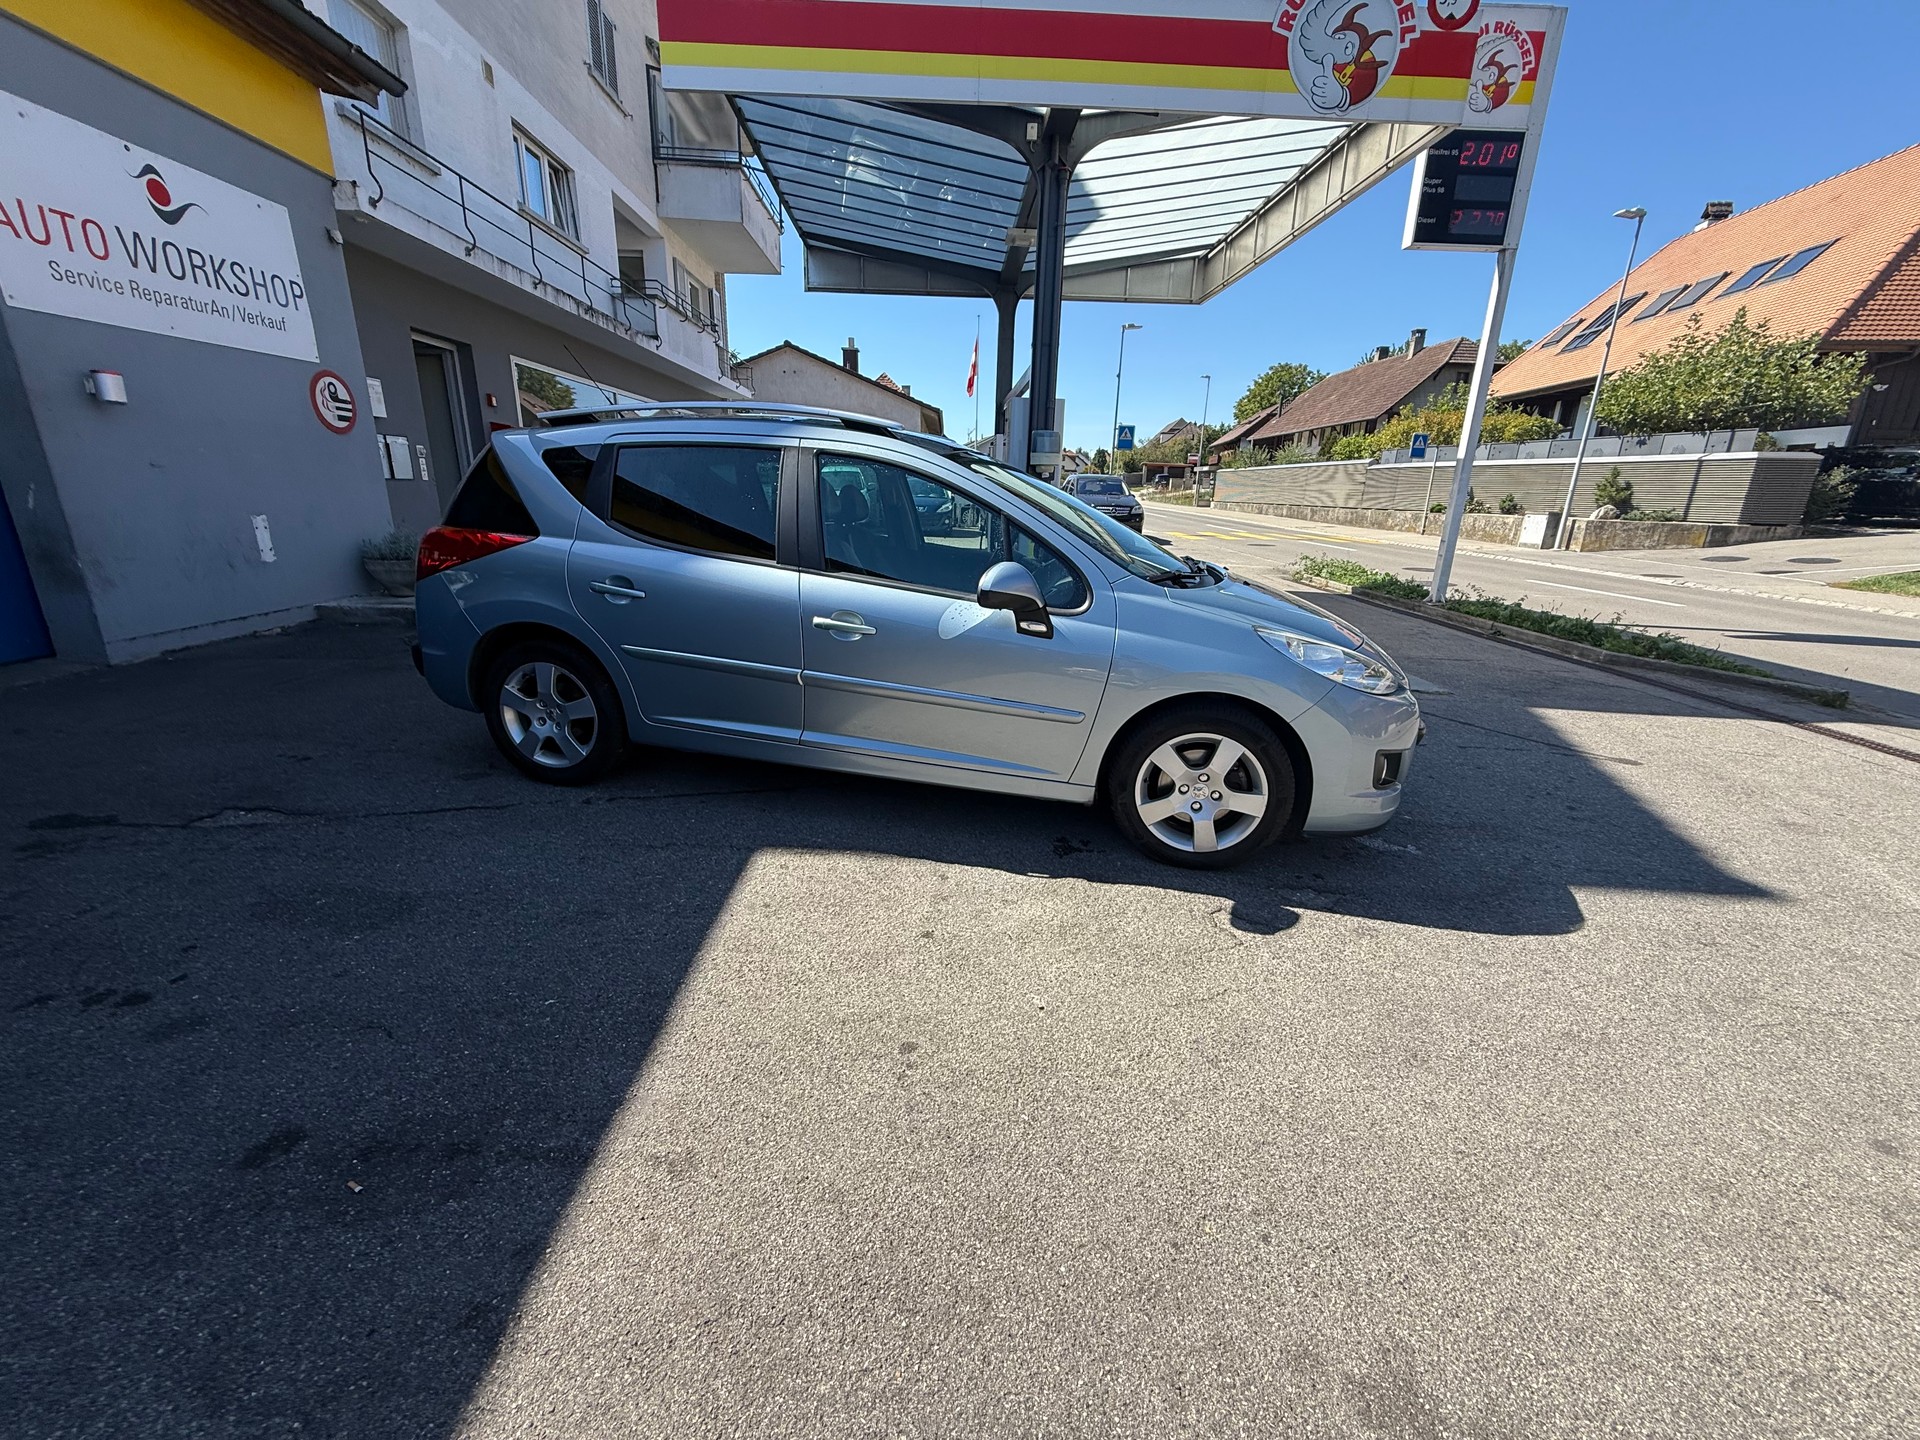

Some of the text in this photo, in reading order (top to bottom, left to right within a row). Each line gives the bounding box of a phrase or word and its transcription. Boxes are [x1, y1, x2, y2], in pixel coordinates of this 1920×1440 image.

[1493, 20, 1533, 71] RÜSSEL
[1422, 186, 1436, 194] Plus
[1423, 177, 1442, 185] Super
[1417, 216, 1436, 224] Diesel
[0, 197, 305, 312] AUTO WORKSHOP
[48, 260, 134, 296] Service
